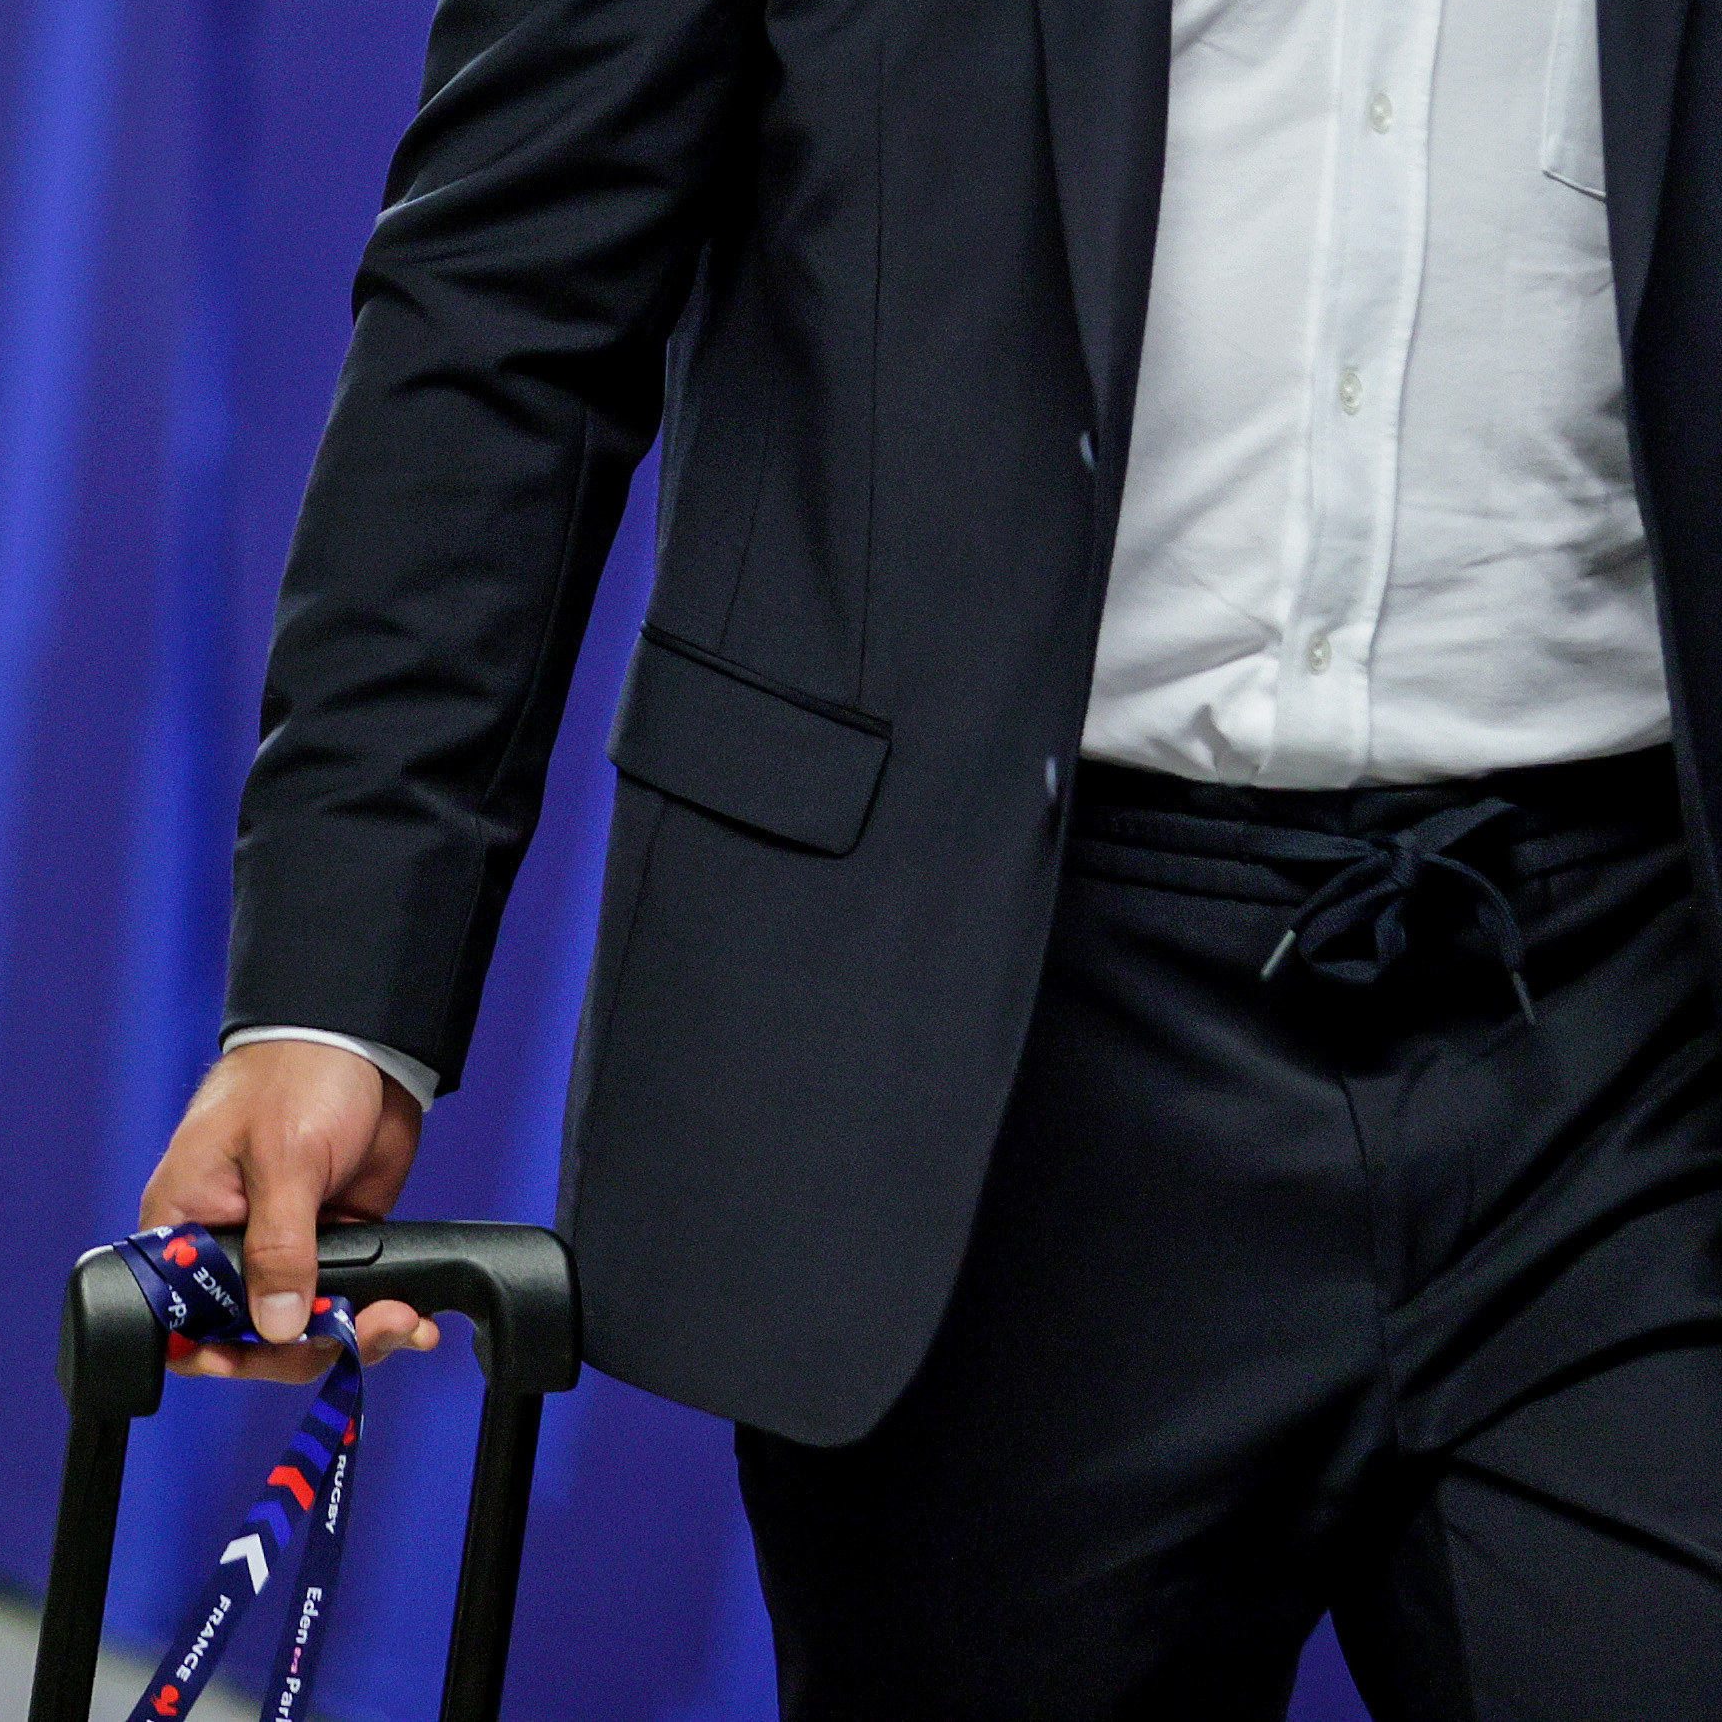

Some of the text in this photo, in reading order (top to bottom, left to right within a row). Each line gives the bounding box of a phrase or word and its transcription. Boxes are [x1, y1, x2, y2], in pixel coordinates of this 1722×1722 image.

[325, 1454, 347, 1534] RUGBY
[176, 1594, 232, 1682] FRANCE
[295, 1586, 323, 1645] Eden
